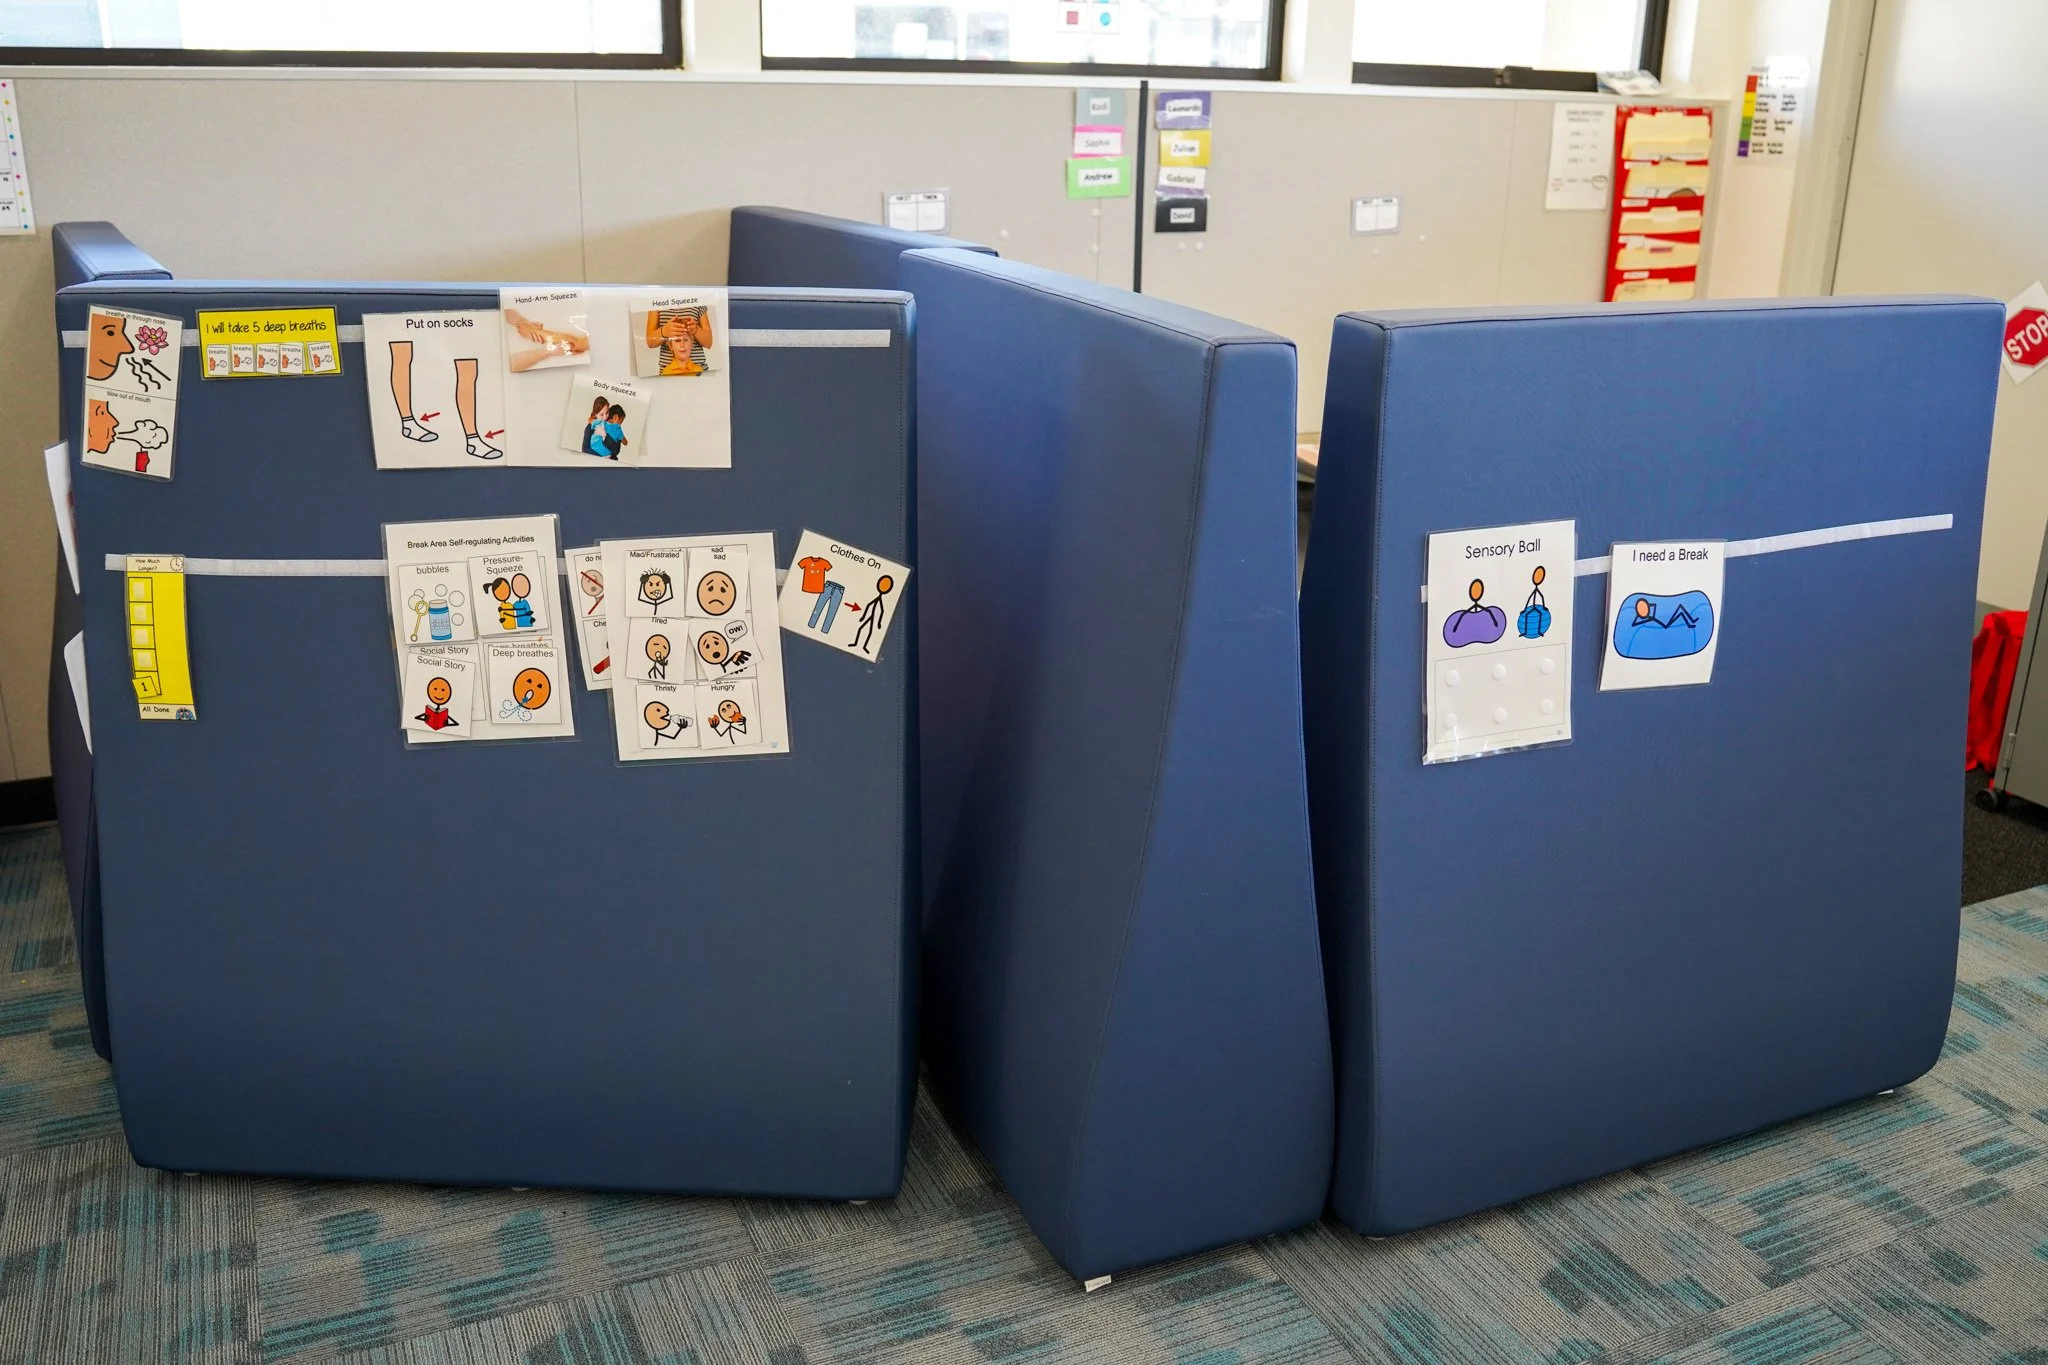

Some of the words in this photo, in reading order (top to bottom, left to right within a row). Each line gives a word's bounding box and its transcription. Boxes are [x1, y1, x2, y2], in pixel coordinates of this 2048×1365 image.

[1084, 173, 1113, 181] Andrew
[1166, 174, 1196, 183] Gabriel
[515, 294, 549, 304] Hand-Arm
[550, 292, 577, 301] Squeeze
[652, 299, 670, 307] Head
[671, 297, 698, 307] Squeeze
[105, 310, 125, 318] breathe
[132, 314, 152, 324] through
[206, 323, 209, 334] I
[212, 322, 225, 333] will
[228, 321, 249, 333] take
[253, 321, 260, 332] 5
[264, 320, 287, 334] deep
[289, 319, 327, 332] breaths
[406, 318, 425, 329] Put
[427, 320, 441, 328] on
[443, 317, 474, 327] socks
[2006, 315, 2048, 360] STOP
[258, 346, 278, 354] breathe
[311, 344, 330, 352] breathe
[106, 390, 119, 398] blow
[593, 380, 609, 391] Body
[611, 385, 637, 397] squeeze
[407, 540, 429, 549] Break
[430, 539, 447, 548] Area
[449, 536, 502, 547] Self-regulating
[502, 535, 535, 544] Activities
[1465, 542, 1516, 560] Sensory
[1518, 538, 1541, 553] Ball
[483, 556, 524, 565] Pressure-
[830, 543, 865, 564] Clothes
[867, 557, 882, 570] On
[1632, 549, 1637, 562] I
[1639, 549, 1666, 562] need
[1668, 552, 1676, 561] a
[1678, 548, 1709, 561] Break
[416, 566, 450, 575] bubbles
[486, 564, 524, 576] Squeeze
[728, 625, 744, 635] OW!
[420, 647, 445, 655] Social
[446, 645, 469, 656] Story
[492, 648, 515, 659] Deep
[517, 648, 554, 658] breathes
[417, 655, 442, 667] Social
[444, 660, 466, 672] Story
[141, 682, 148, 692] 1
[711, 683, 736, 692] Hungry
